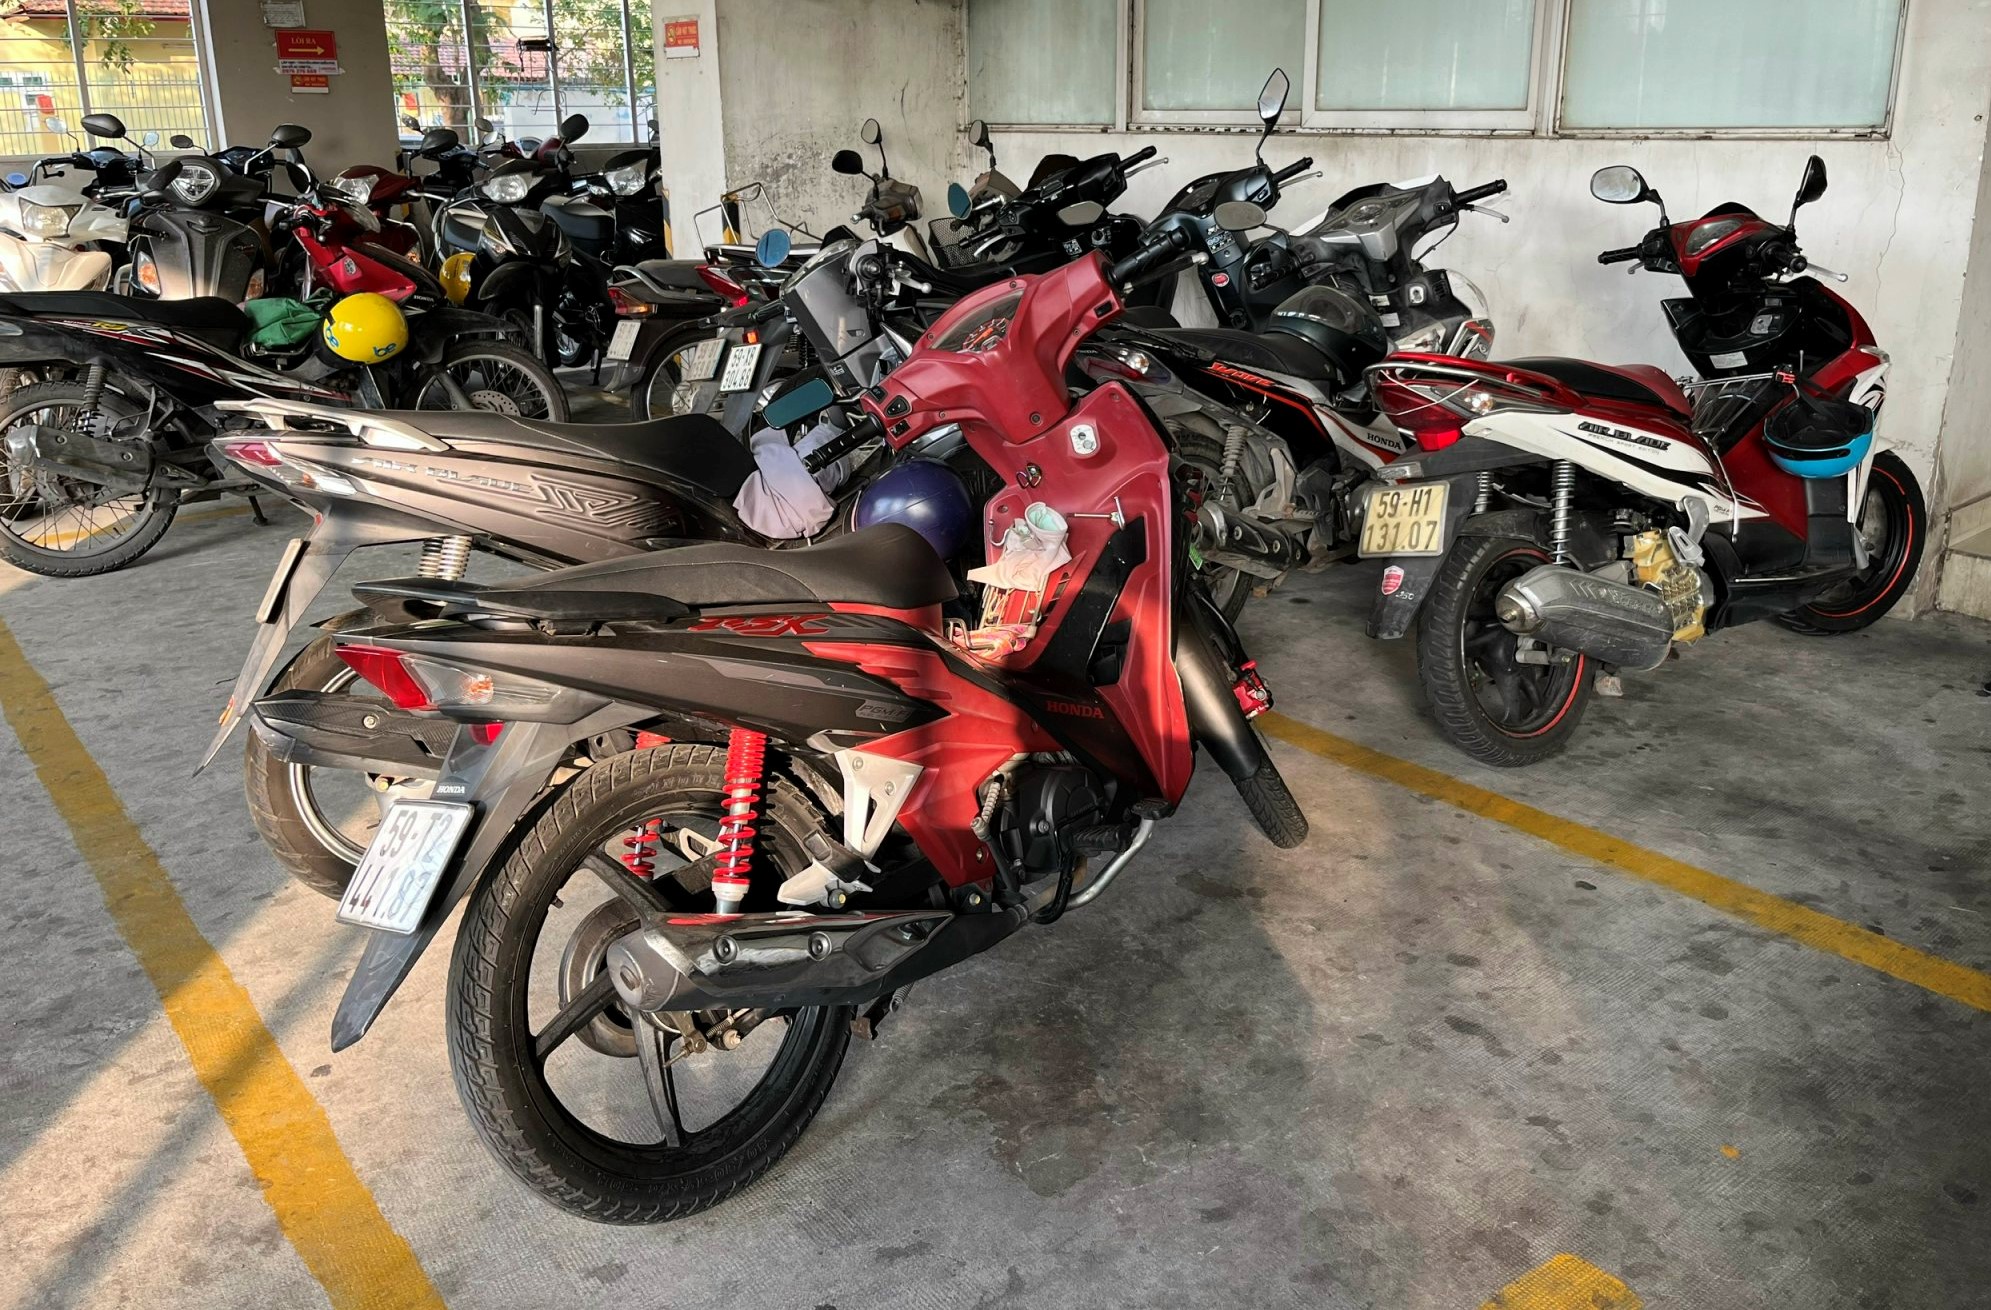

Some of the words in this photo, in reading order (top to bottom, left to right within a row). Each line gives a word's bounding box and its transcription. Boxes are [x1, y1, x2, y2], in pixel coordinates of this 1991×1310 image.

[373, 343, 397, 357] be
[1366, 432, 1402, 450] HONDA
[1376, 487, 1433, 519] 59-H1
[1366, 520, 1438, 552] 131.07
[1046, 701, 1105, 719] HONDA
[436, 785, 466, 794] HONDA
[379, 810, 453, 864] 59-T2
